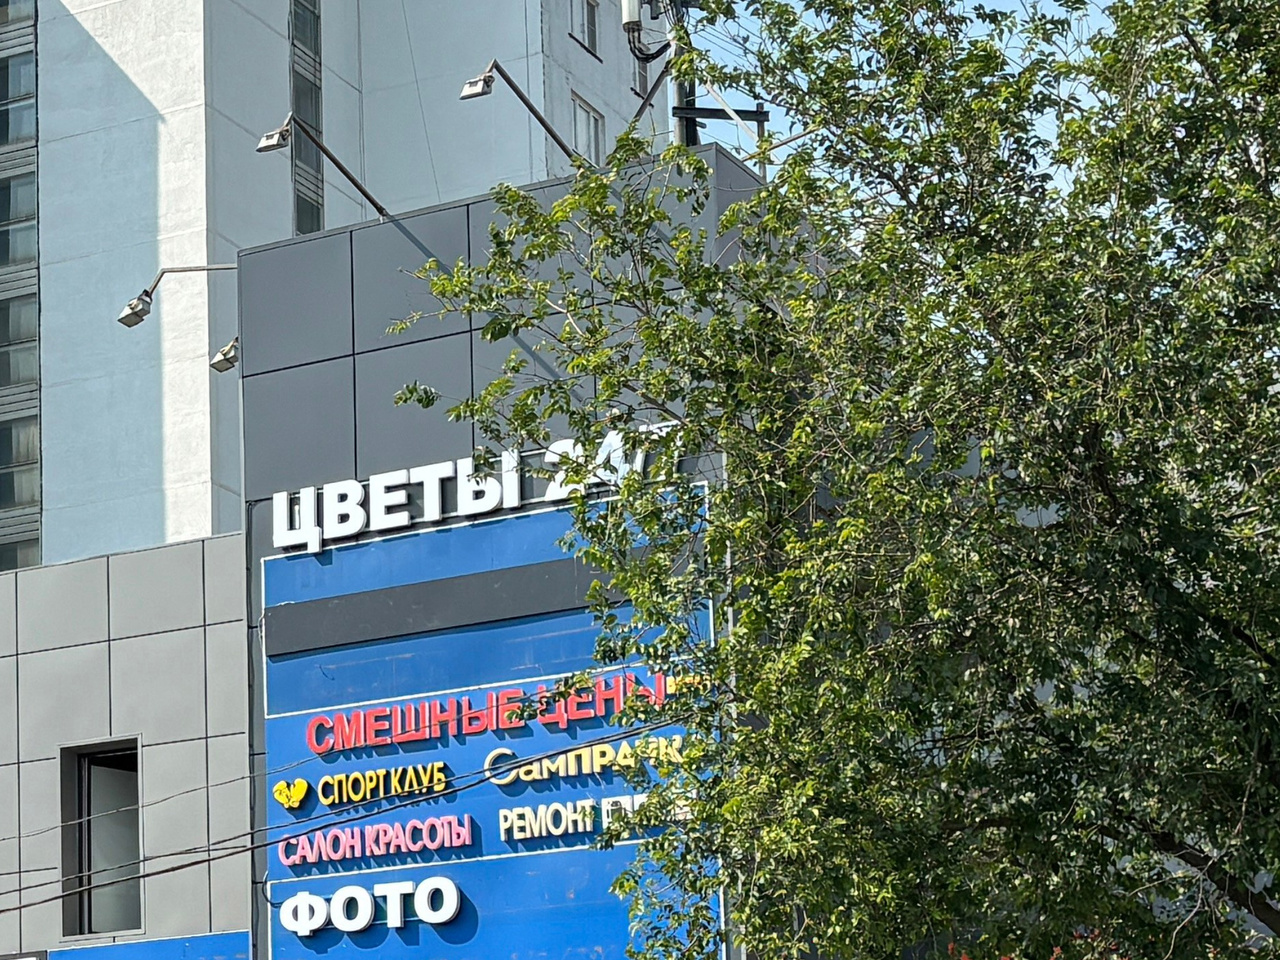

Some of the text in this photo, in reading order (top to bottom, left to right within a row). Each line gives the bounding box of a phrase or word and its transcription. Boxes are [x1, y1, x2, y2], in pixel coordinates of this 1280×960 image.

[272, 447, 521, 553] ЦВЕТЫ
[306, 671, 665, 754] СМЕШНЫЕ ЦЕНЫ
[317, 760, 447, 806] СПОРТ КЛУБ
[278, 813, 472, 867] САЛОН КРАСОТЫ
[498, 799, 595, 842] РЕМОНТ
[279, 875, 461, 937] ФОТО
